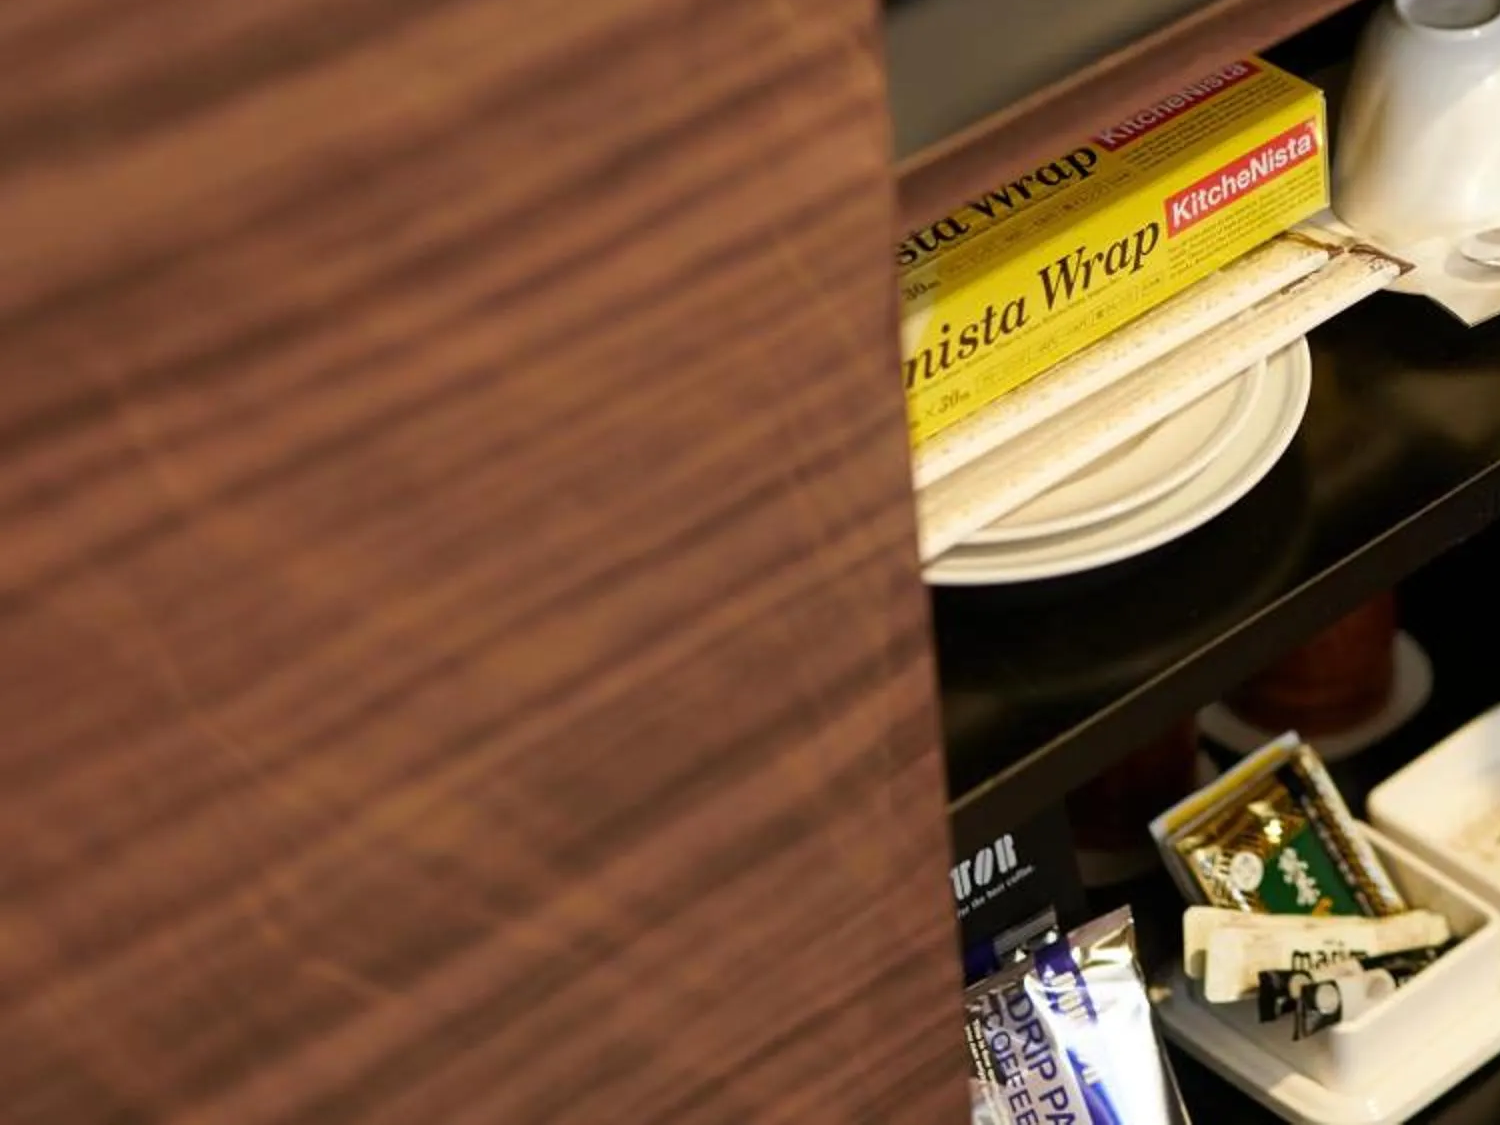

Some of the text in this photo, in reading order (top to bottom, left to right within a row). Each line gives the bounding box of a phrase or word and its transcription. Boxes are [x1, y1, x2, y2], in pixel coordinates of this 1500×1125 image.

[1171, 133, 1312, 228] KitcheNista
[1038, 221, 1160, 311] Wrap
[1004, 990, 1057, 1081] DRIP
